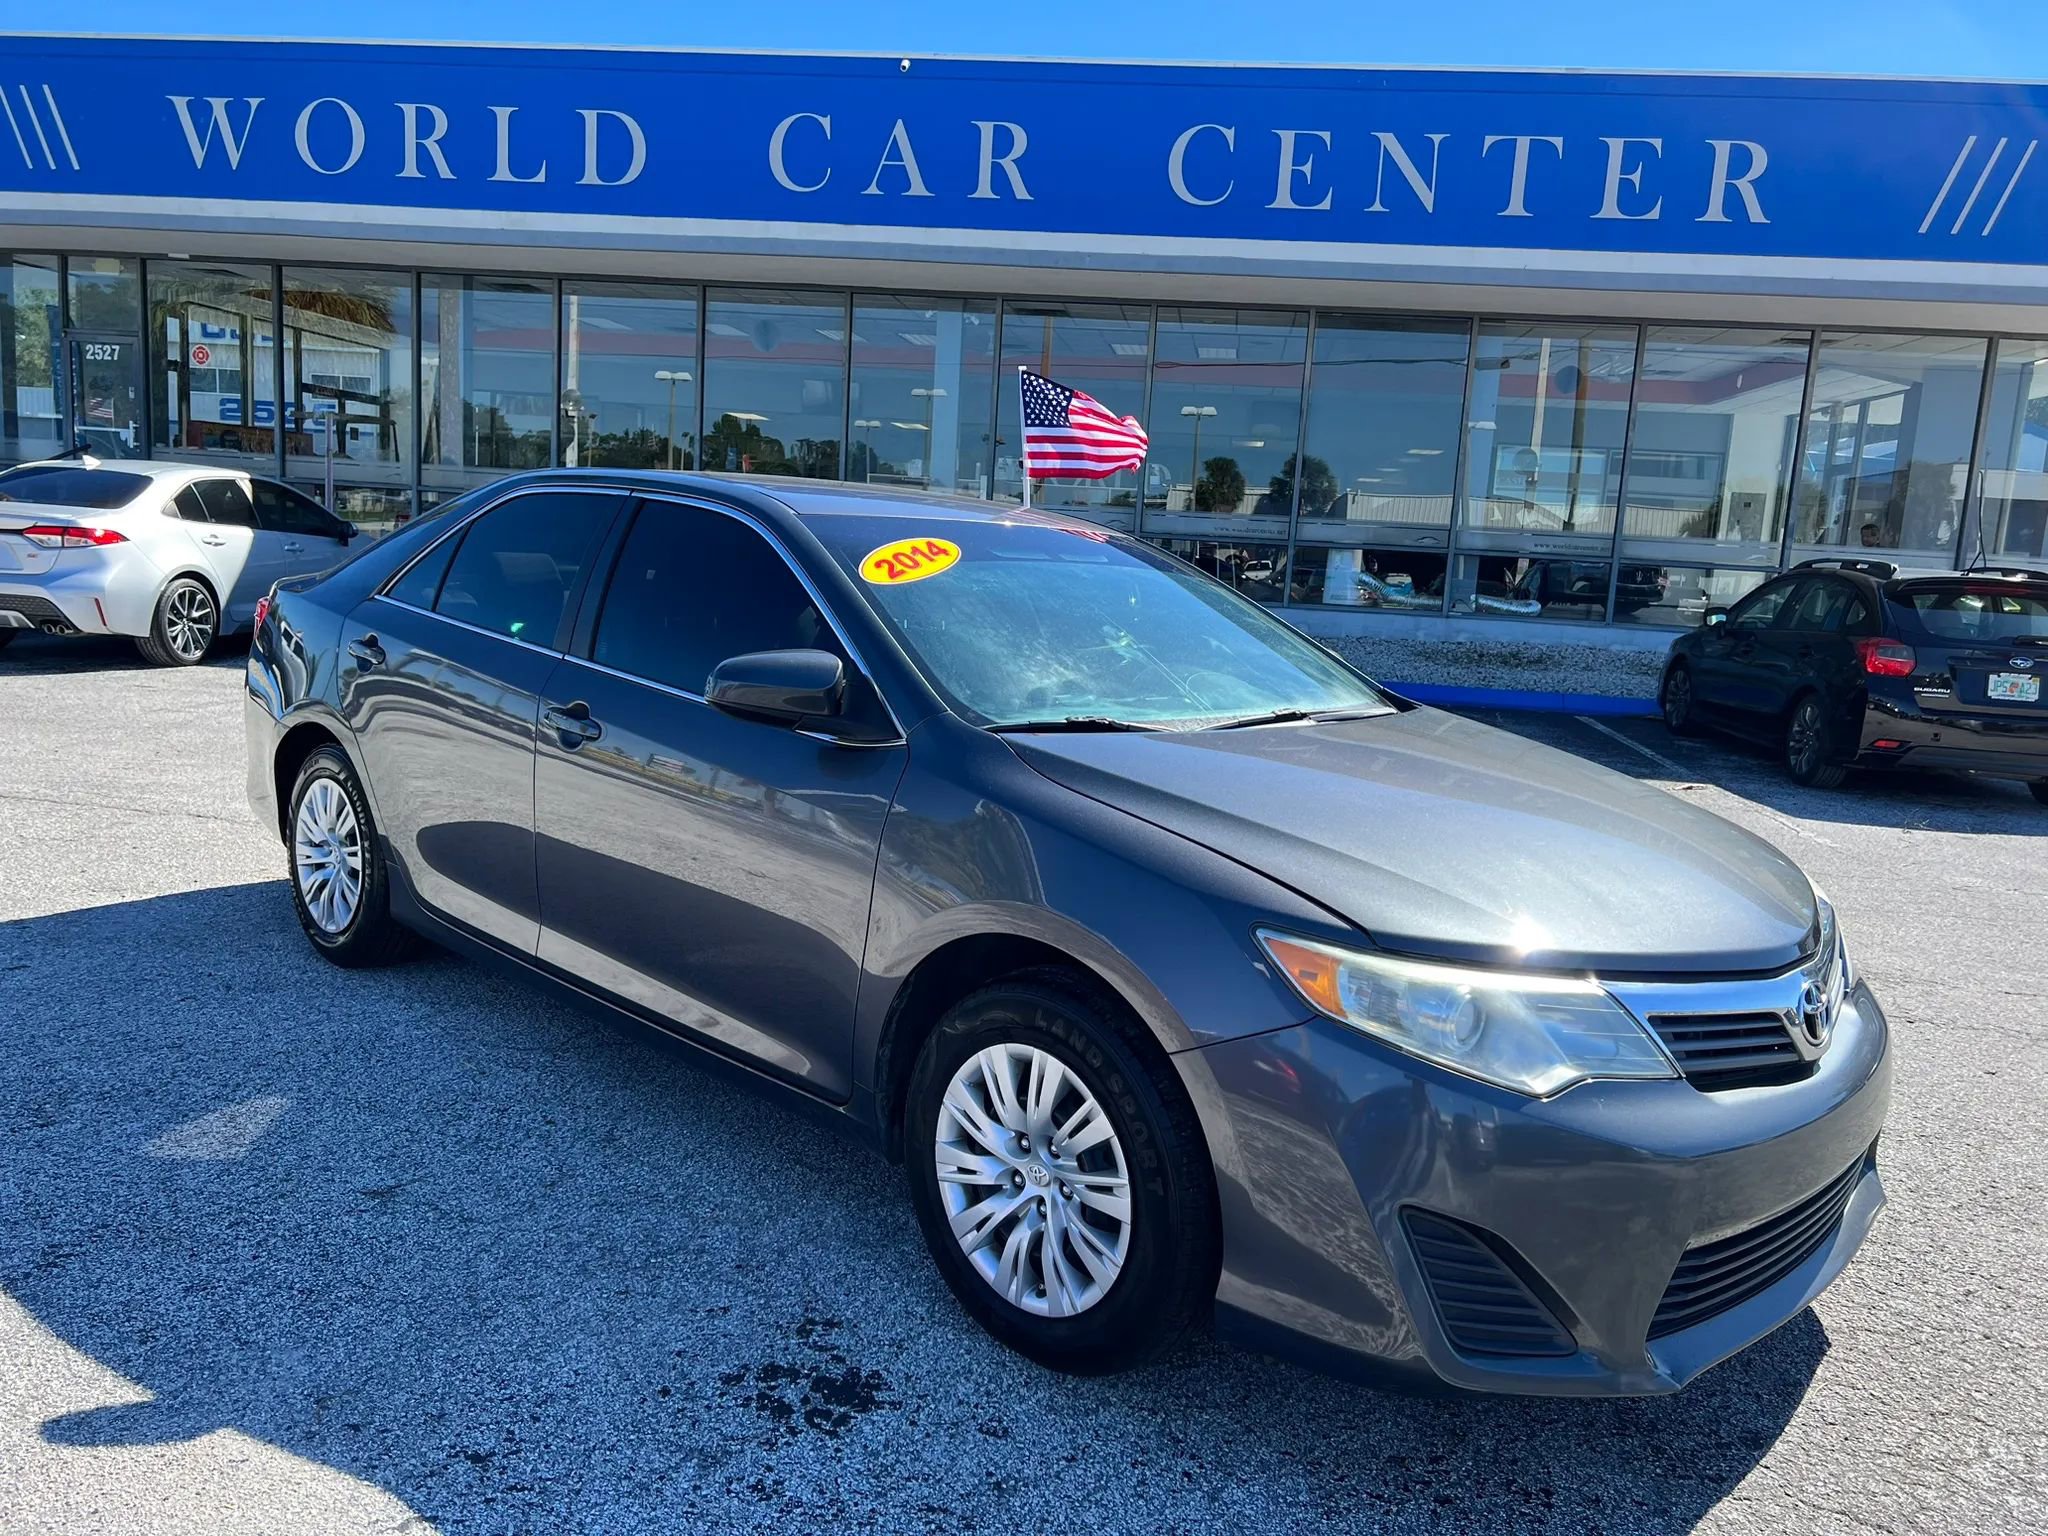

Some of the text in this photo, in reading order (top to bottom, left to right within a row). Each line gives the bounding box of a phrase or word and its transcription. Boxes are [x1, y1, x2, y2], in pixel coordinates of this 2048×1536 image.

[167, 96, 1772, 224] WORLD CAR CENTER
[85, 344, 120, 361] 2527
[874, 540, 950, 580] 2014
